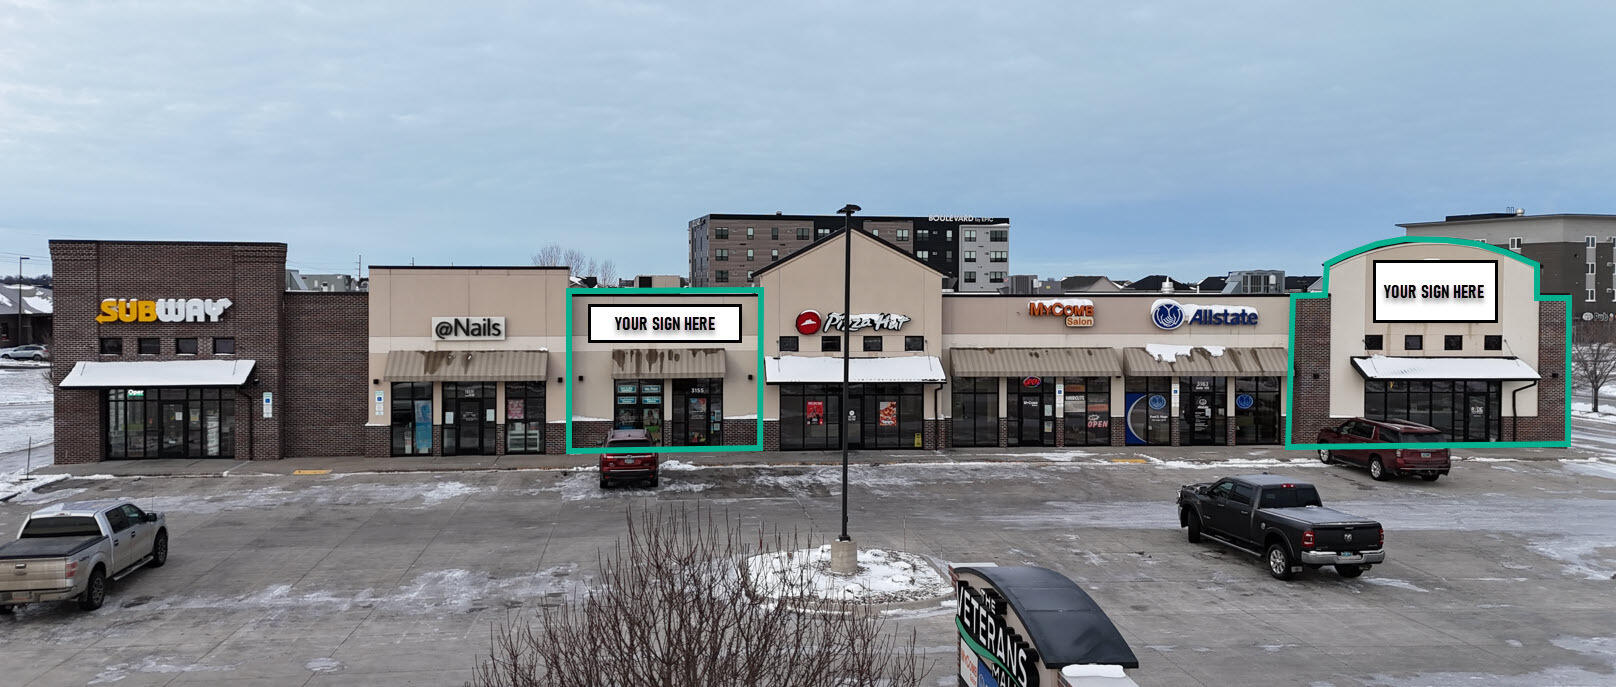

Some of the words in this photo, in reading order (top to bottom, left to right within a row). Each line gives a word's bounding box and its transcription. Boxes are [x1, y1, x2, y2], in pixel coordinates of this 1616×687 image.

[928, 214, 973, 222] BOULEVARD
[95, 298, 233, 323] SUBWAY
[1189, 308, 1258, 326] Allstate
[435, 318, 502, 339] @Nails
[871, 312, 911, 331] Hut
[1066, 317, 1093, 326] Salon
[1087, 420, 1109, 428] OPEN
[980, 589, 995, 614] THE
[956, 581, 1027, 687] VETERANS
[991, 663, 1018, 687] MA
